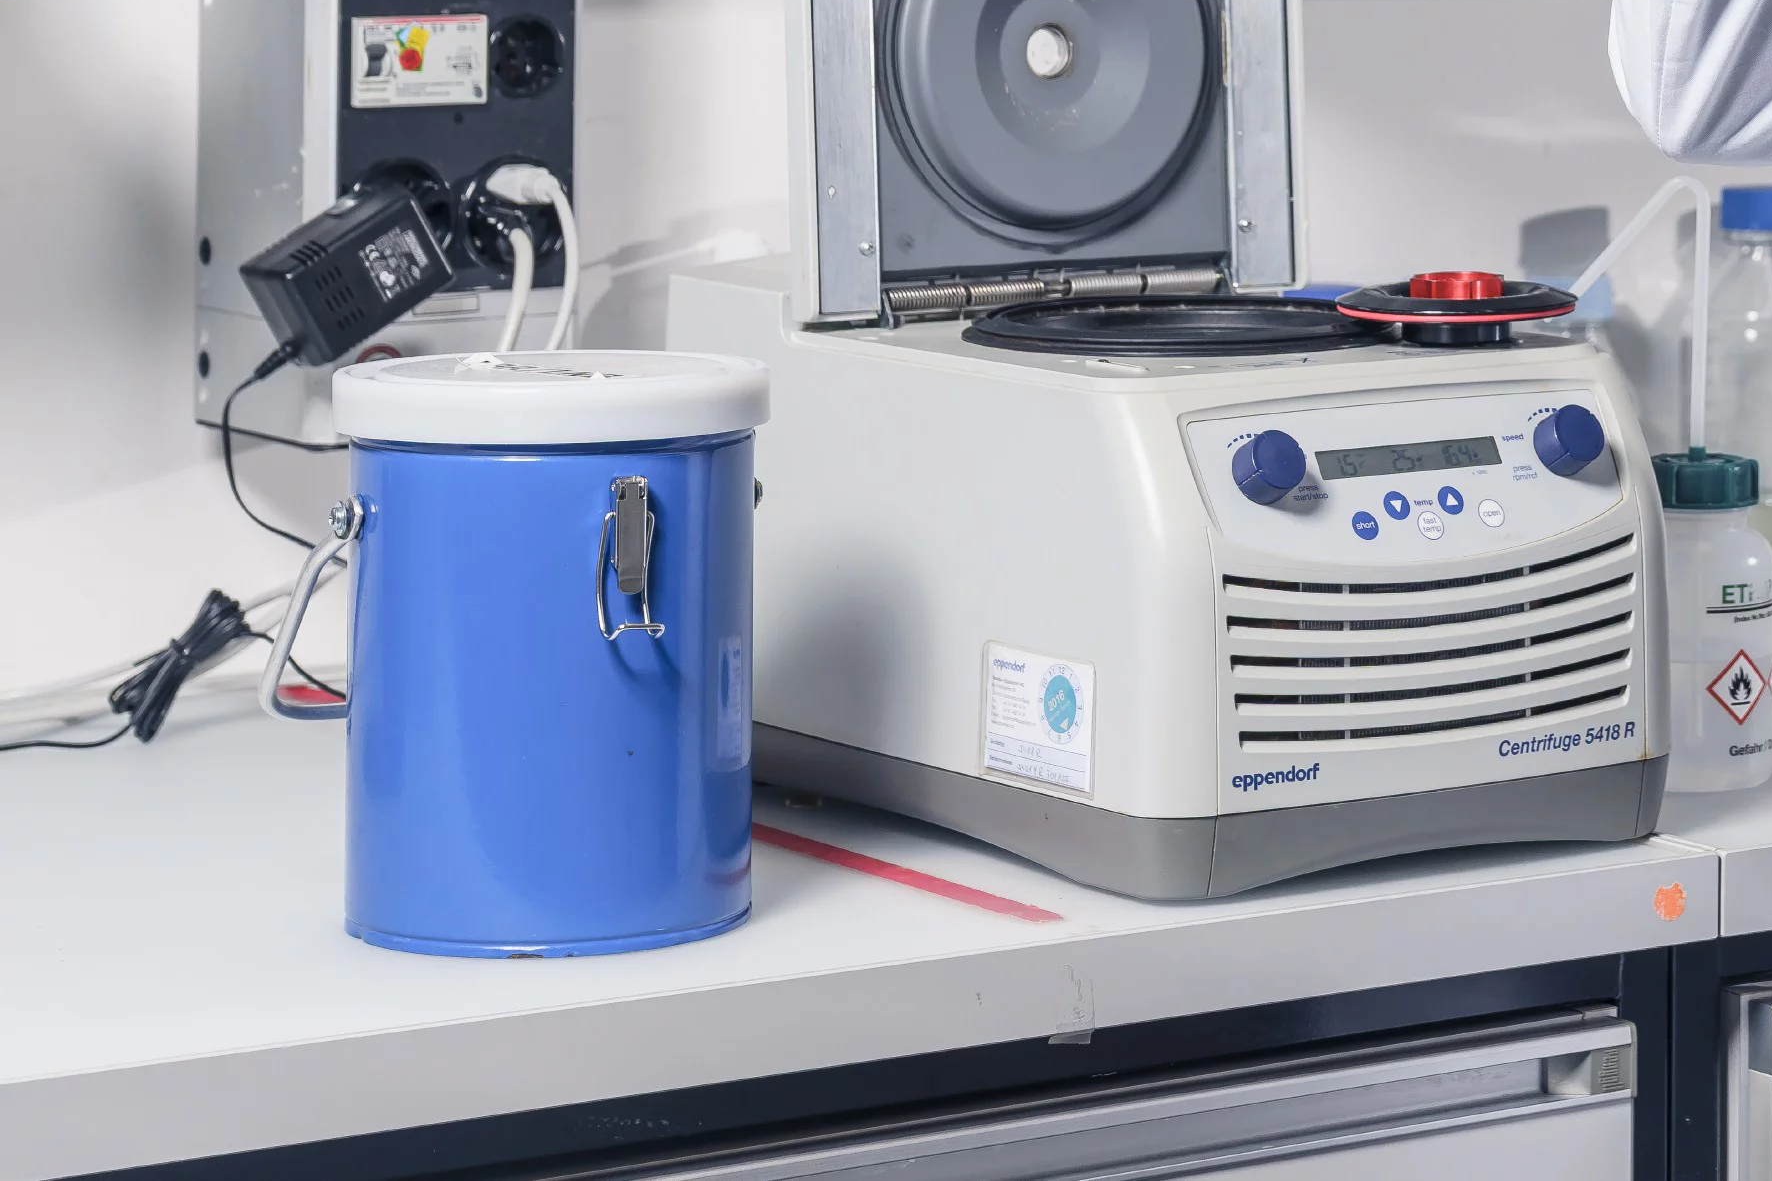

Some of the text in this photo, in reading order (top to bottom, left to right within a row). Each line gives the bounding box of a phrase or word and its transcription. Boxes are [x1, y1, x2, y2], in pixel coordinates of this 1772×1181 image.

[1501, 433, 1525, 442] speed
[1512, 465, 1533, 474] press
[1512, 472, 1538, 482] rpm/rcf
[1298, 484, 1319, 494] press
[1293, 492, 1329, 502] start/stop
[1413, 499, 1434, 507] temp
[1482, 510, 1502, 518] open
[1355, 521, 1376, 530] short
[1423, 516, 1438, 525] fast
[1423, 525, 1442, 533] temp
[993, 658, 1026, 674] eppendorf
[1047, 689, 1065, 712] 2016
[1499, 721, 1636, 758] Centrifuge 5418 R
[1729, 742, 1764, 757] Gefahr
[1231, 762, 1320, 792] eppendorf
